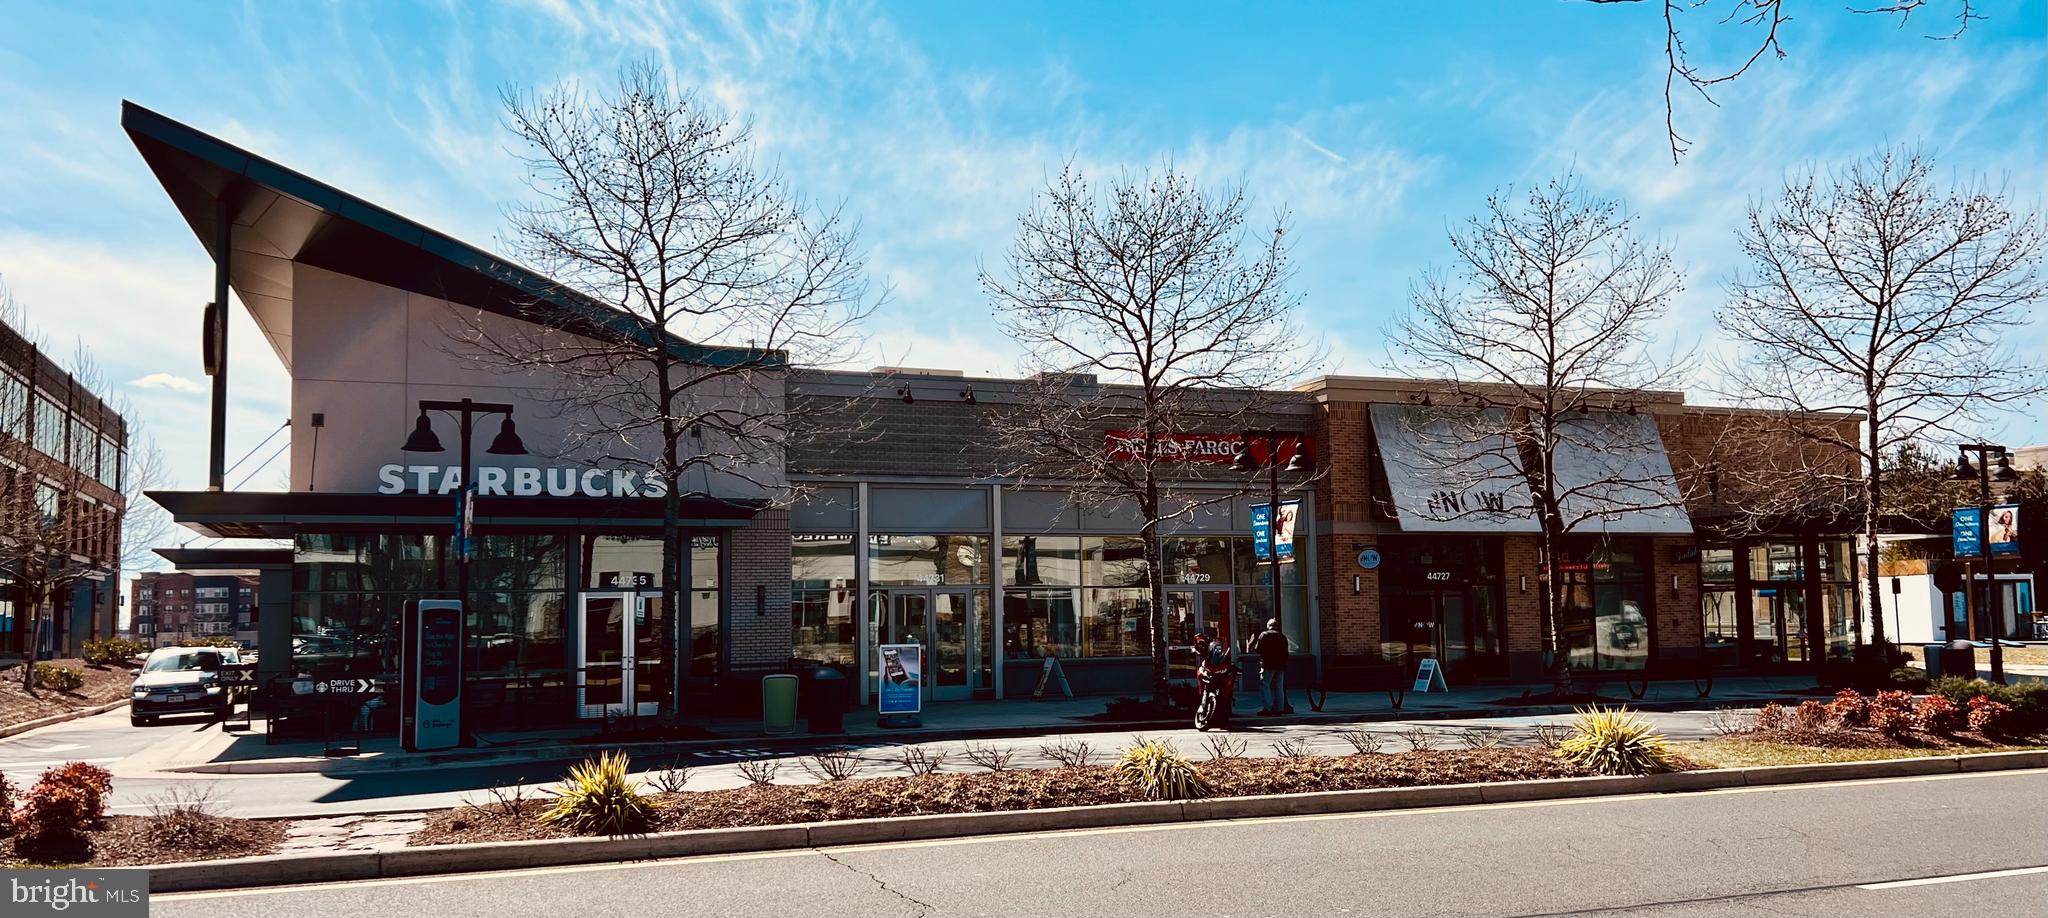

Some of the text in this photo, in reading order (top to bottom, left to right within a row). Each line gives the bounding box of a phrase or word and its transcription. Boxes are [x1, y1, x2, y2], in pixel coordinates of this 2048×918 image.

[378, 464, 669, 498] STARBUCKS
[611, 575, 647, 585] 44735
[1184, 573, 1210, 582] 44729
[1427, 572, 1450, 580] 44727
[330, 679, 355, 687] DRIVE
